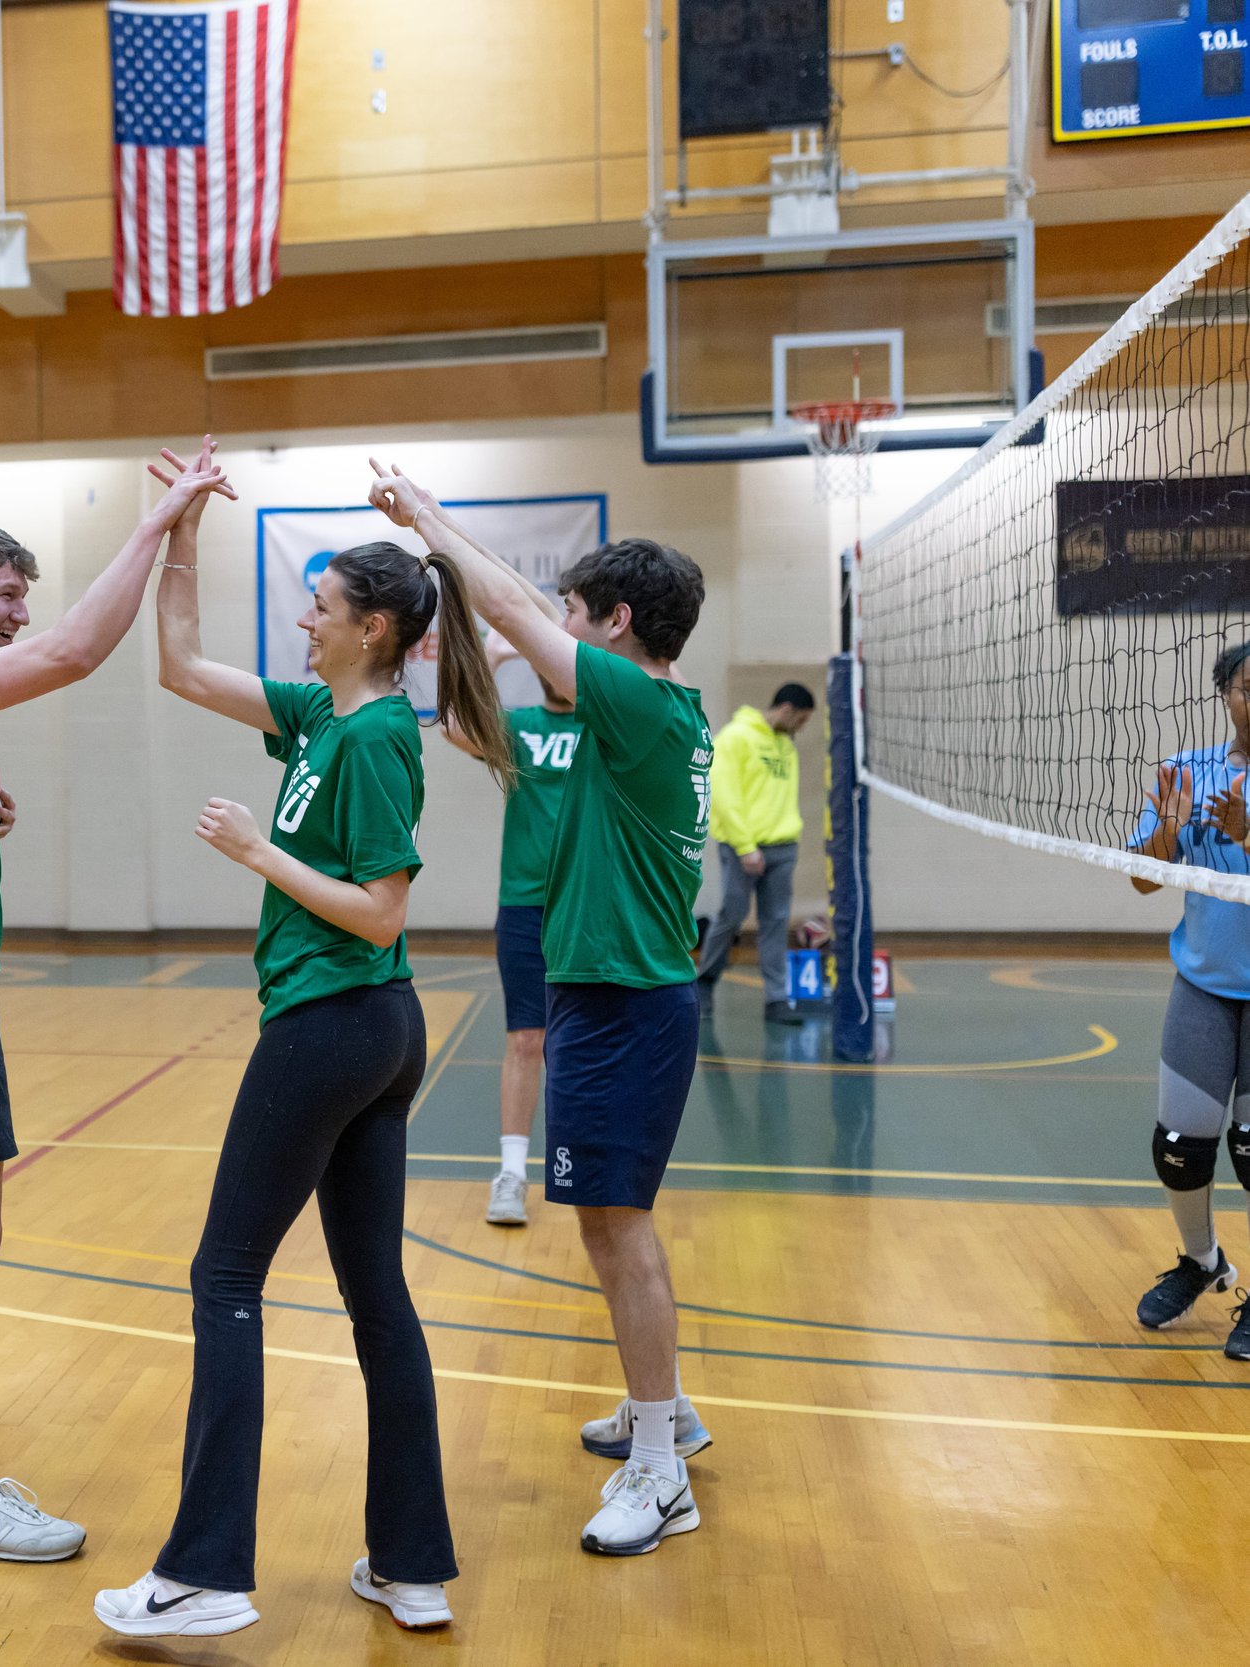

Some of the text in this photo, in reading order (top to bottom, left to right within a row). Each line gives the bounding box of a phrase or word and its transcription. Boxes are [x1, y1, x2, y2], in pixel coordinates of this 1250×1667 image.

[1080, 38, 1138, 63] FOULS
[1081, 104, 1141, 129] SCORE
[235, 1308, 250, 1319] alo
